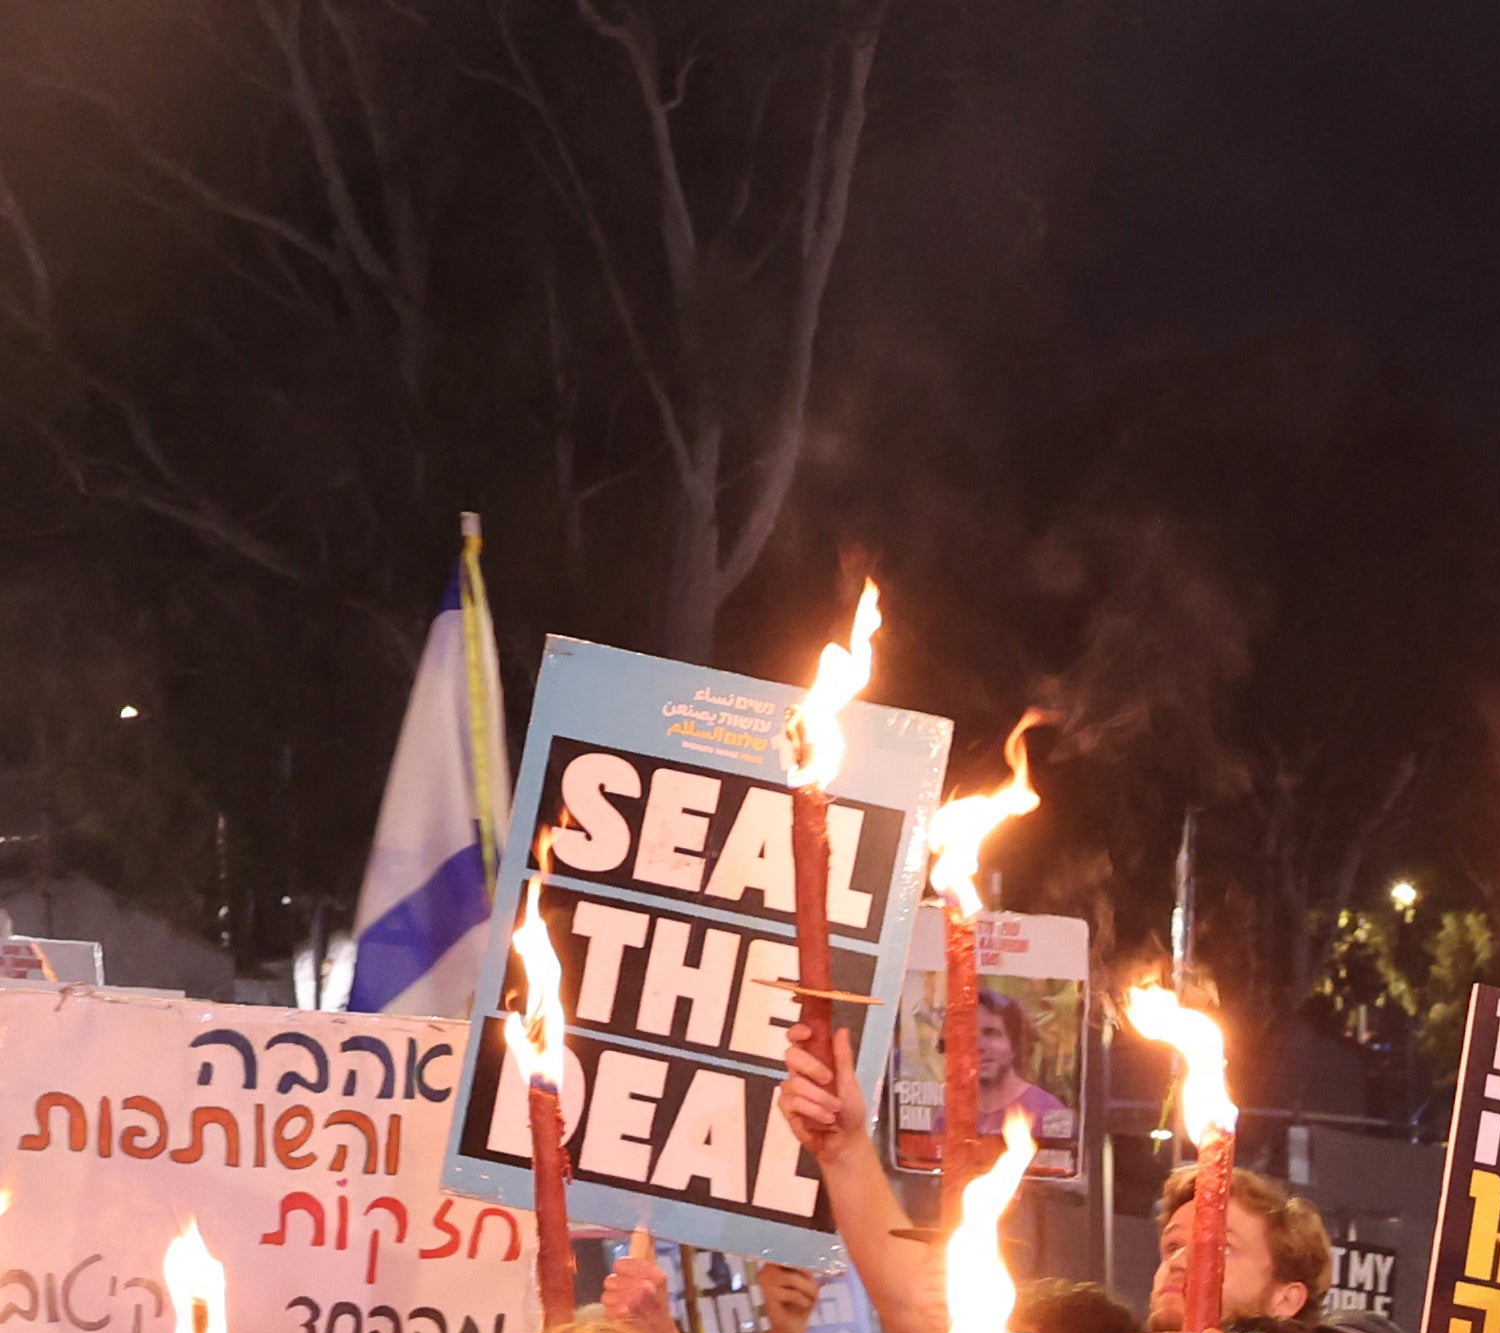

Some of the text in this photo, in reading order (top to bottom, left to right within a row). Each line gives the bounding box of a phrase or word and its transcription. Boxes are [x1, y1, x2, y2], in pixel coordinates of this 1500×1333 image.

[552, 752, 873, 928] SEAL
[571, 901, 805, 1061] THE
[190, 1029, 453, 1102] אהבה
[19, 1092, 402, 1174] והשותפות
[486, 1048, 822, 1219] DEAL
[260, 1185, 522, 1285] חזקות
